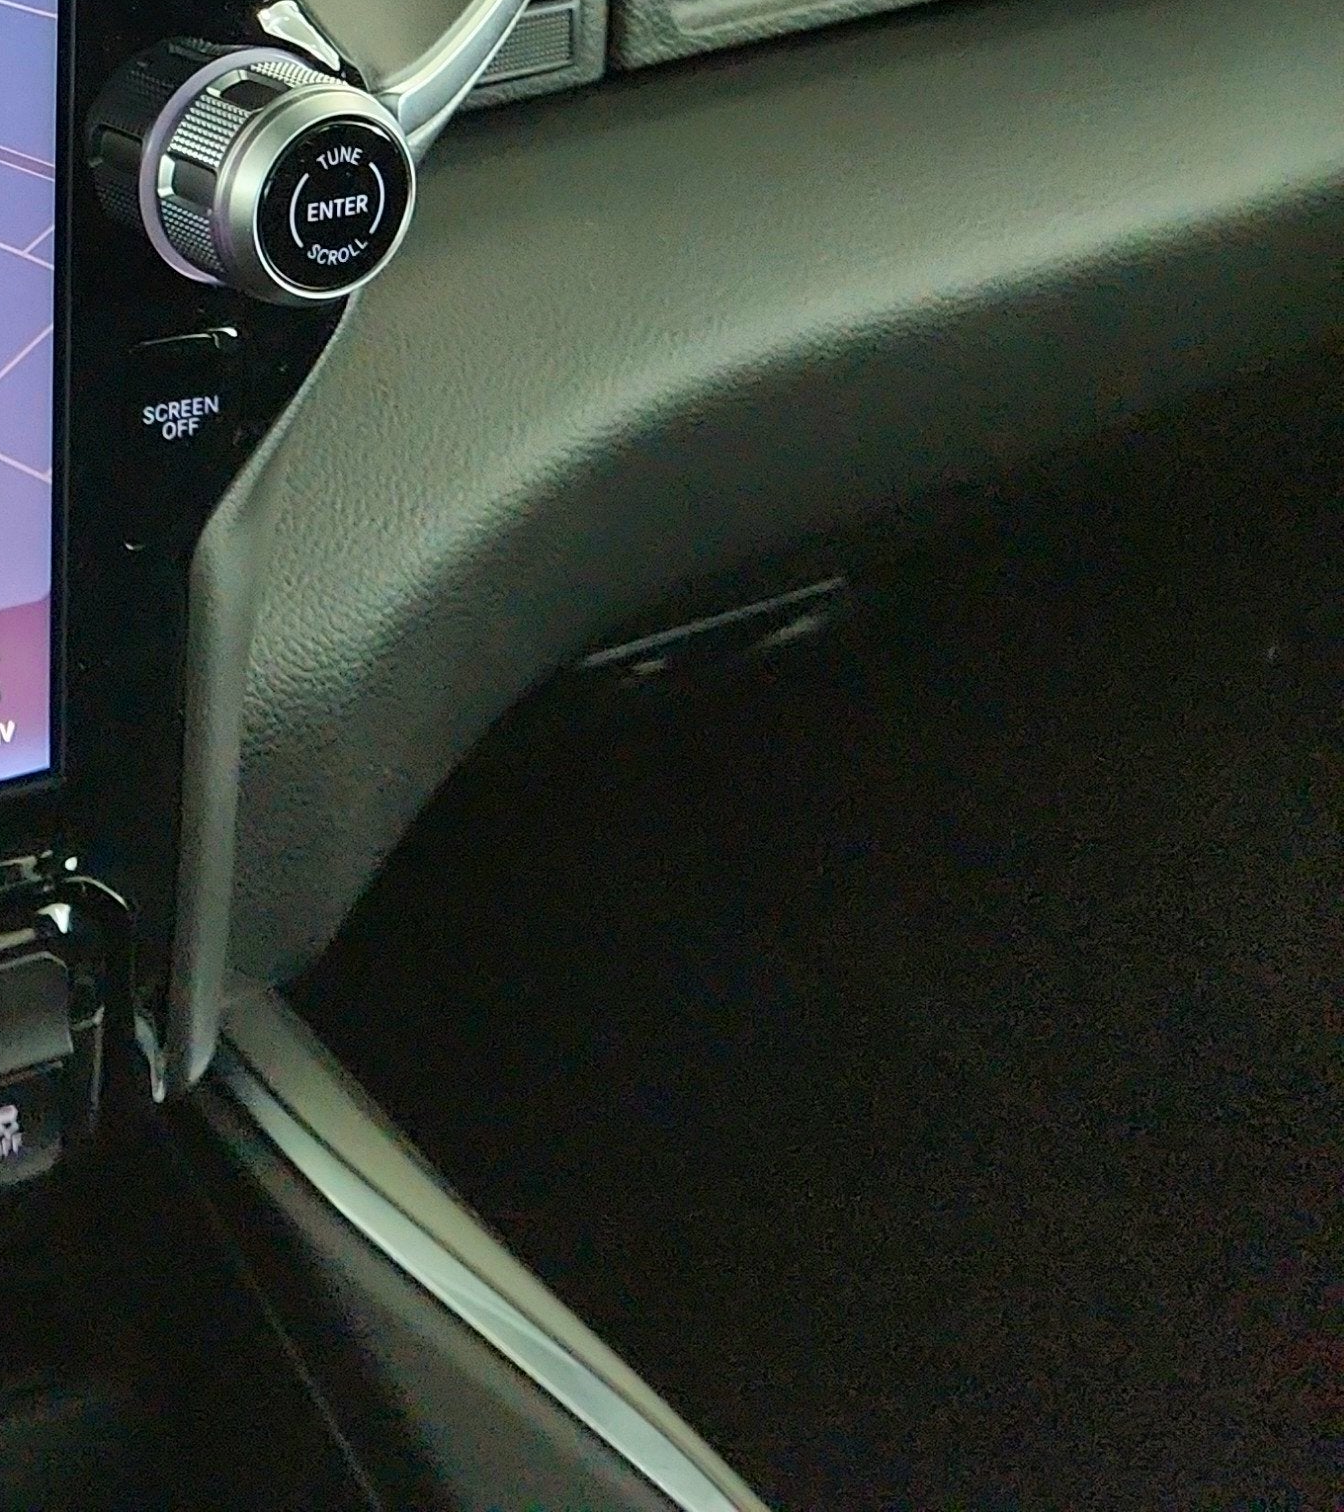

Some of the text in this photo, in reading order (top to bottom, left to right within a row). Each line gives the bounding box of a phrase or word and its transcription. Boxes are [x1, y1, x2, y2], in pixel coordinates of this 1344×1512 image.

[316, 145, 363, 170] TUNE
[307, 194, 369, 223] ENTER
[307, 238, 369, 266] SCROLL
[143, 394, 220, 425] SCREEN
[162, 415, 200, 441] OFF
